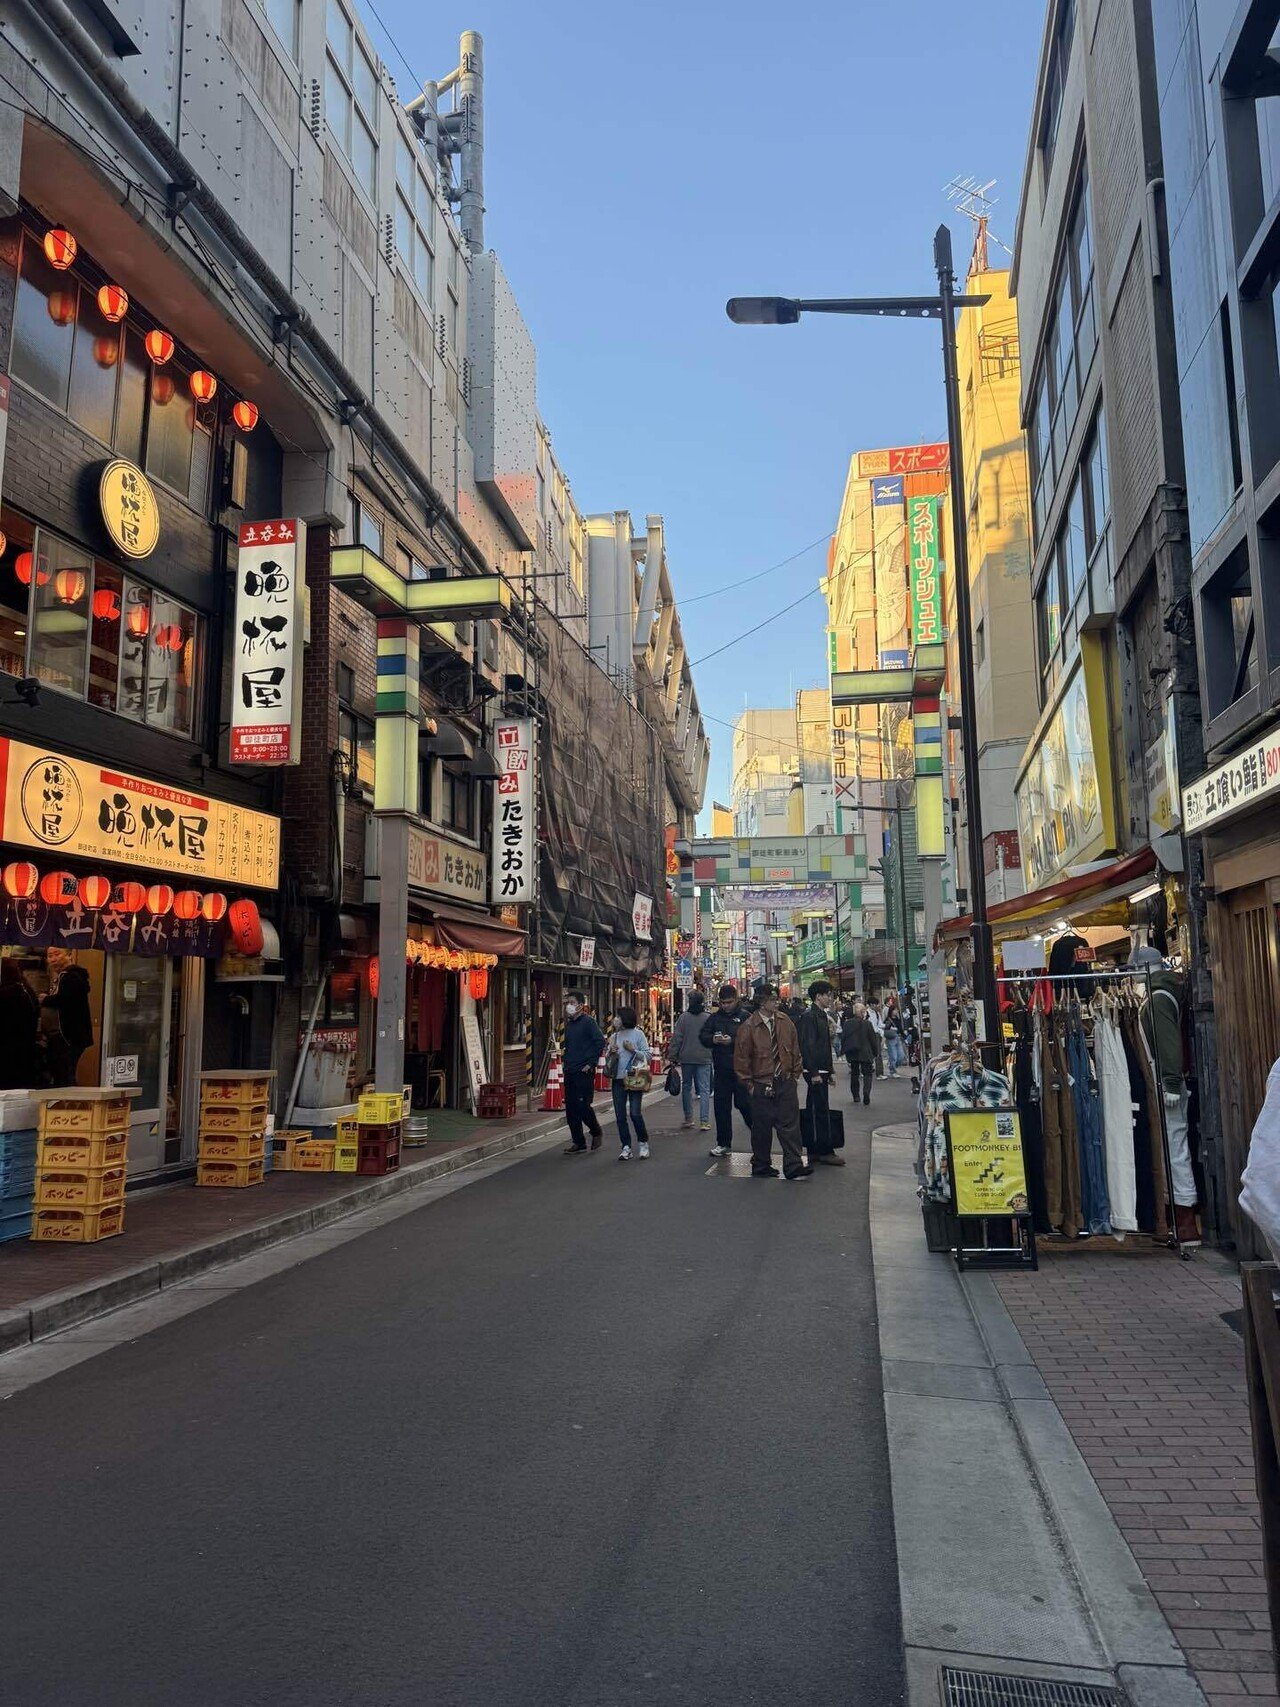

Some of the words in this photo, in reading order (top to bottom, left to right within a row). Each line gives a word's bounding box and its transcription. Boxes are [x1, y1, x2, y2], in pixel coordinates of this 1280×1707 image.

[243, 523, 293, 543] 立呑み
[914, 502, 937, 643] スポーツジュエ
[499, 727, 528, 793] 立飲み
[500, 799, 524, 896] たきおか
[444, 852, 484, 891] たきおか
[59, 896, 167, 945] 立呑み
[50, 1115, 89, 1126] ホッピー
[48, 1152, 86, 1163] ホッピー
[45, 1188, 83, 1199] ホッピー
[42, 1225, 80, 1237] ホッピー
